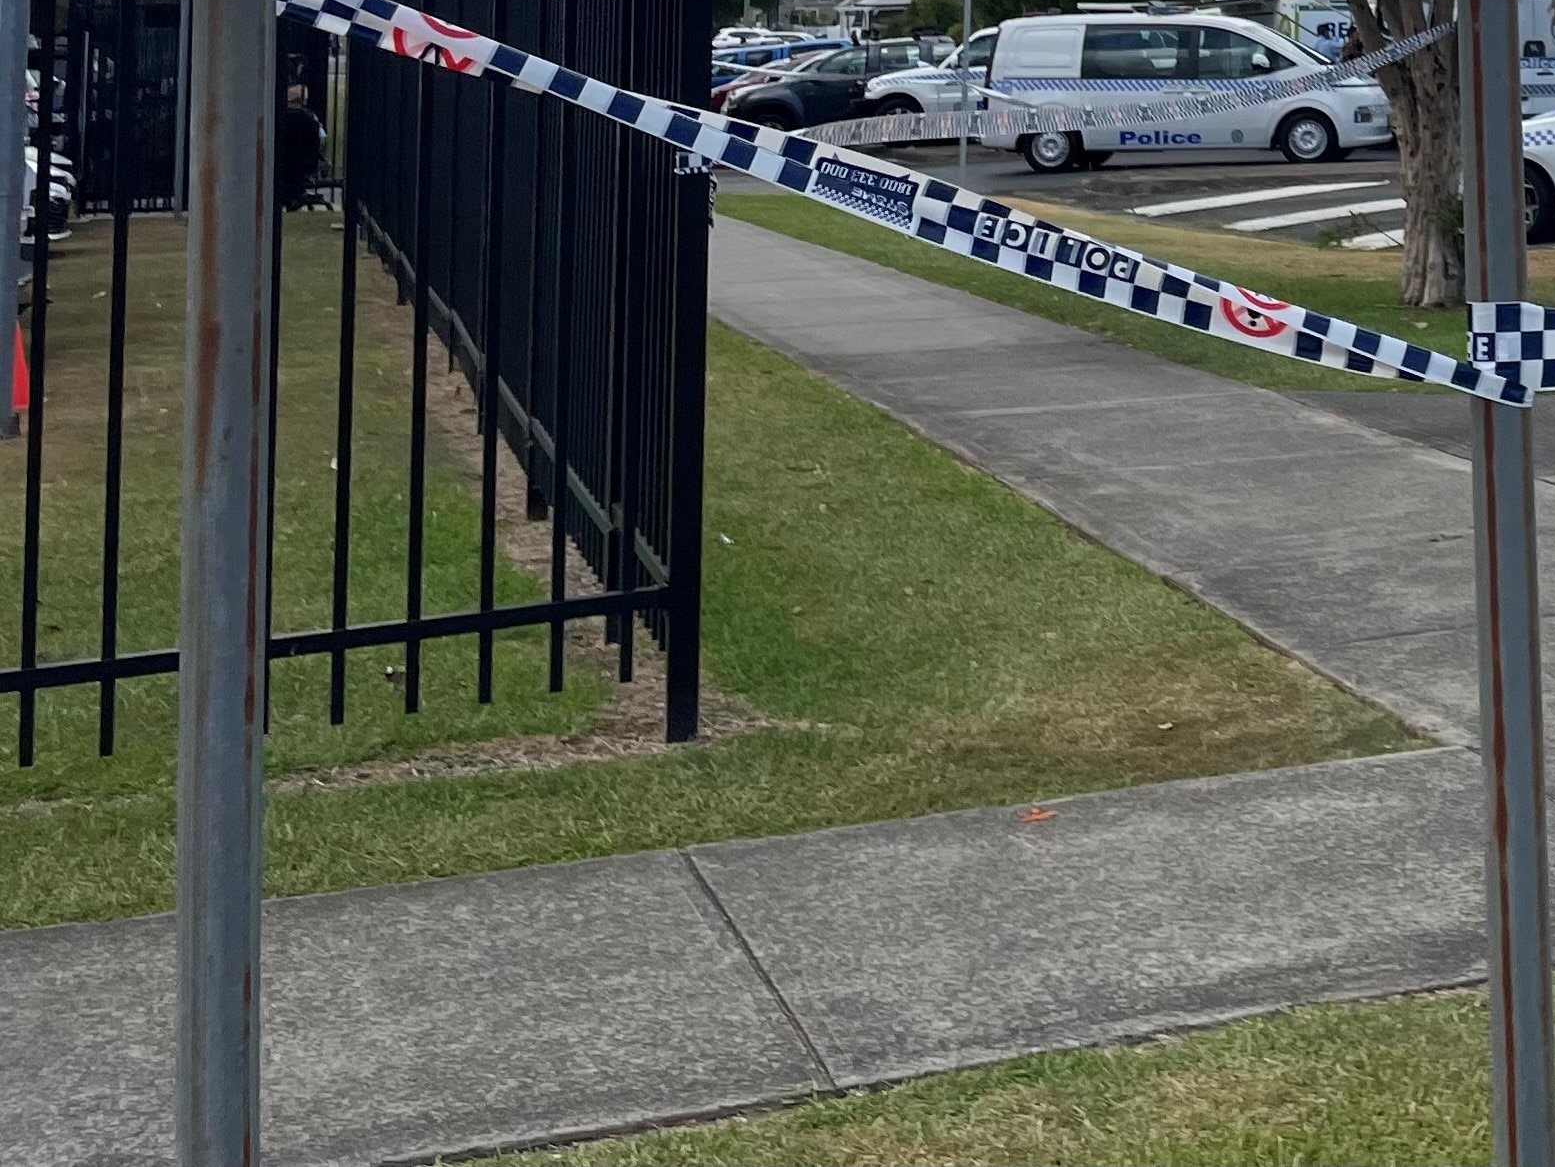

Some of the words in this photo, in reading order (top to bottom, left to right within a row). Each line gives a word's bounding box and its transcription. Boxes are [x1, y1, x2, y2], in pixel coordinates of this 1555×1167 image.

[1118, 130, 1203, 146] Police
[820, 161, 849, 179] 000
[850, 171, 878, 187] 333
[879, 176, 914, 196] 1800
[981, 217, 1135, 281] POLICE
